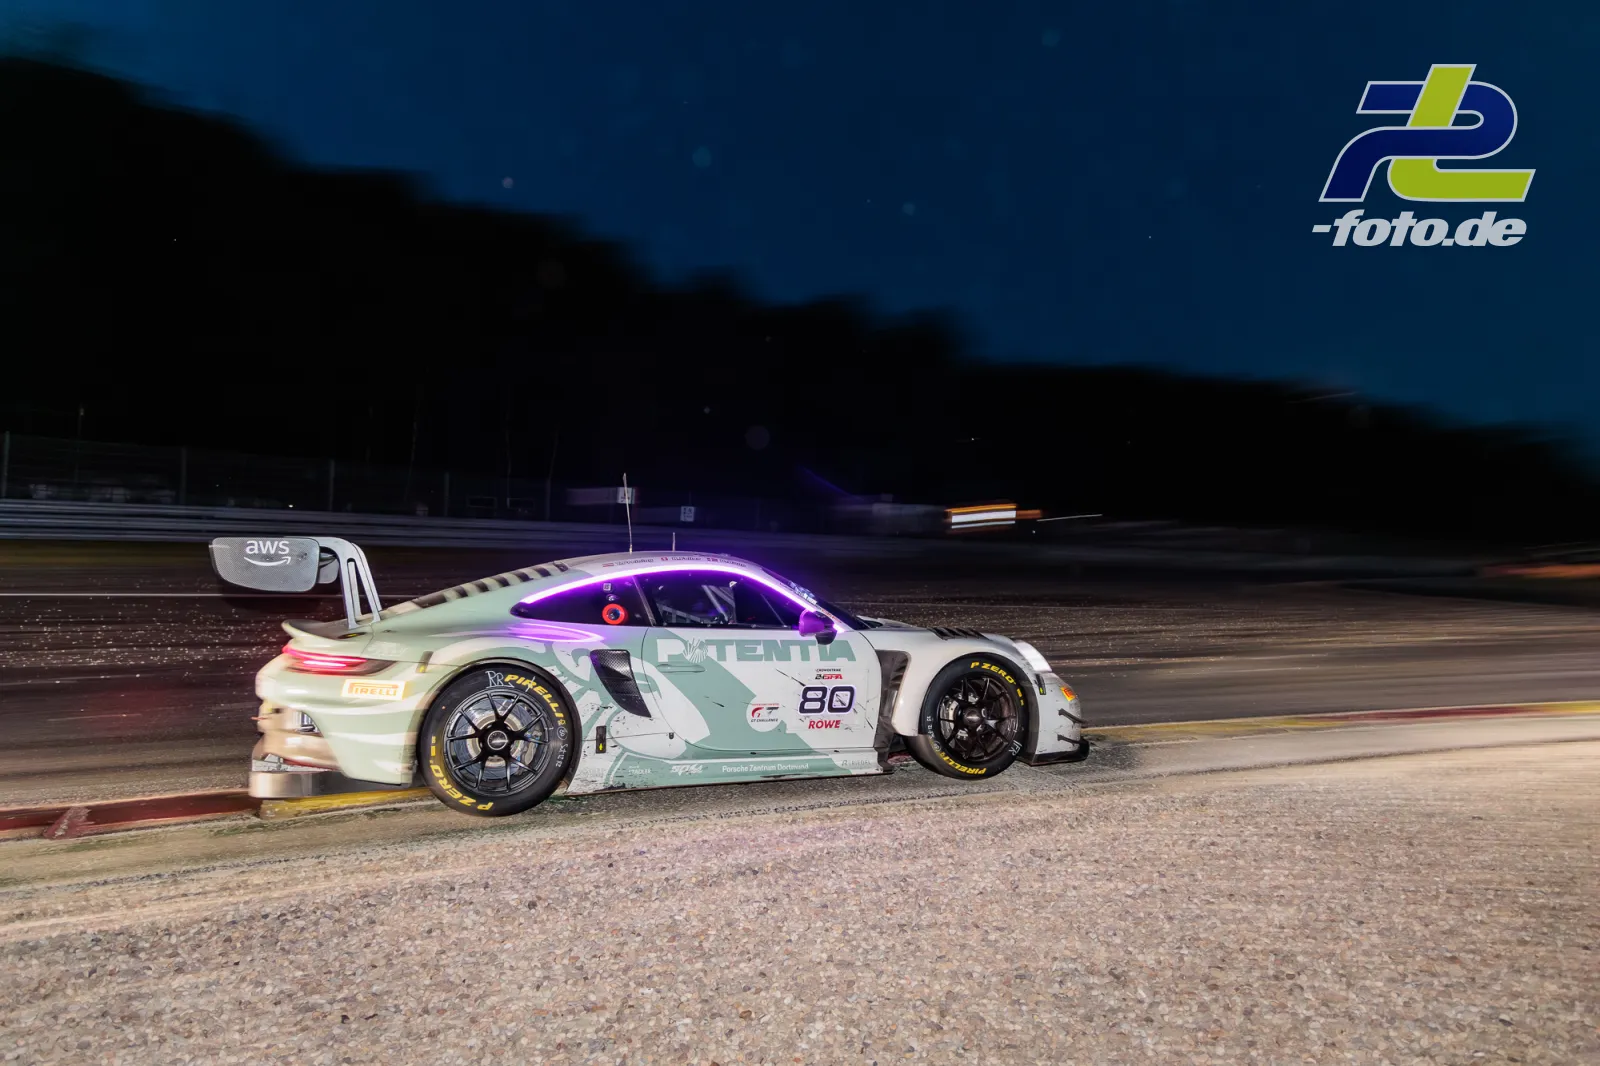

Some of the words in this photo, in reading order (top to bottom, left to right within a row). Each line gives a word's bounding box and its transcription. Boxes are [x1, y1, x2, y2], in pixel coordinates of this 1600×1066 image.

[245, 540, 290, 554] aws
[981, 663, 1015, 685] ZERO
[348, 683, 399, 696] PIRELLI
[504, 674, 565, 718] PIRELLI
[799, 685, 856, 714] 80
[808, 720, 841, 729] ROWE
[722, 765, 748, 773] Porsche
[749, 764, 776, 772] Zentrum
[943, 755, 987, 775] PIRELLI
[430, 764, 477, 807] ZERO
